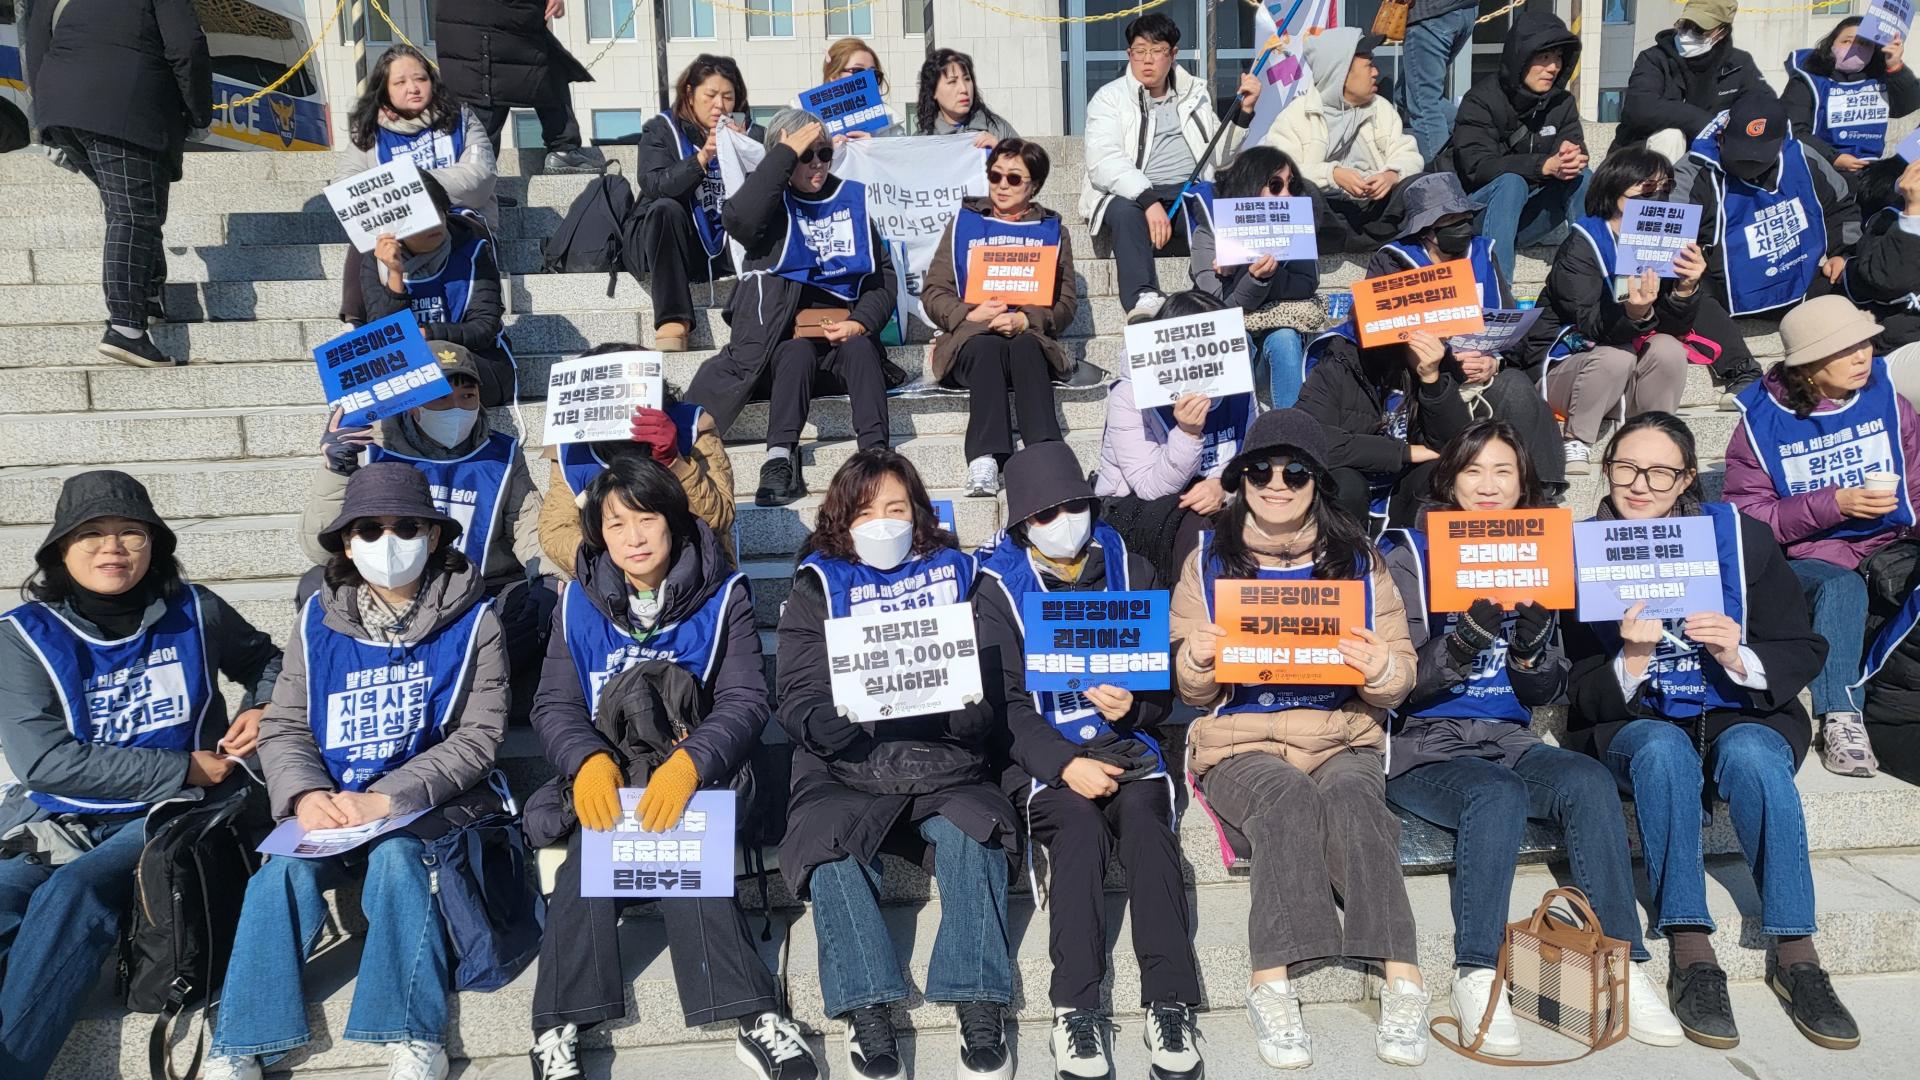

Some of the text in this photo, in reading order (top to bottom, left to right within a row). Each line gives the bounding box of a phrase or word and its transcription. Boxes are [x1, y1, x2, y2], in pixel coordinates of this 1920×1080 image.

[212, 89, 260, 135] ICE
[1846, 94, 1879, 108] 완전한
[347, 171, 395, 199] 자립지원
[371, 181, 424, 208] 1,000명
[868, 182, 968, 210] 애인부모연대
[360, 204, 413, 232] 실시하라!
[1640, 206, 1666, 218] 사회적
[812, 226, 835, 242] 전한
[983, 251, 1041, 262] 발달장애인
[1372, 266, 1453, 293] 발달장애인
[1376, 286, 1457, 311] 국가책임제
[1423, 304, 1481, 323] 보장하라
[1483, 312, 1524, 323] 수학급
[1154, 321, 1216, 344] 자립지원
[325, 322, 405, 369] 발달장애인
[1130, 336, 1246, 369] 본사업 1,000명
[338, 350, 408, 391] 권리예산
[551, 370, 577, 388] 학대
[580, 363, 622, 383] 예방을
[1158, 361, 1224, 385] 실시하라!
[552, 409, 579, 426] 지원
[1779, 441, 1808, 457] 장애,
[1856, 418, 1885, 436] 넘어
[1809, 445, 1863, 476] 완전한
[1449, 518, 1544, 538] 발달장애인
[1605, 524, 1682, 541] 사회적 참사
[1459, 542, 1537, 563] 권리예산
[1606, 544, 1684, 562] 예방을 위한
[1456, 568, 1549, 589] 확보하라!!
[1580, 563, 1656, 582] 발달장애인
[850, 584, 880, 603] 장애,
[929, 565, 956, 582] 넘어
[1619, 582, 1685, 600] 확대하라!
[1241, 587, 1340, 605] 발달장애인
[1042, 600, 1150, 620] 발달장애인
[862, 618, 939, 645] 자립지원
[1241, 617, 1340, 635] 국가책임제
[1053, 628, 1140, 648] 권리예산
[148, 646, 178, 665] 넘어
[832, 639, 976, 674] 본사업 1,000명
[1027, 652, 1169, 673] 국회는 응답하라
[1222, 646, 1345, 664] 실행예산 보장하
[346, 661, 424, 690] 발달장애인
[865, 668, 949, 696] 실시하라!
[340, 681, 429, 717] 지역사회
[340, 707, 420, 743] 자립생활
[613, 869, 702, 891] 특수학급
